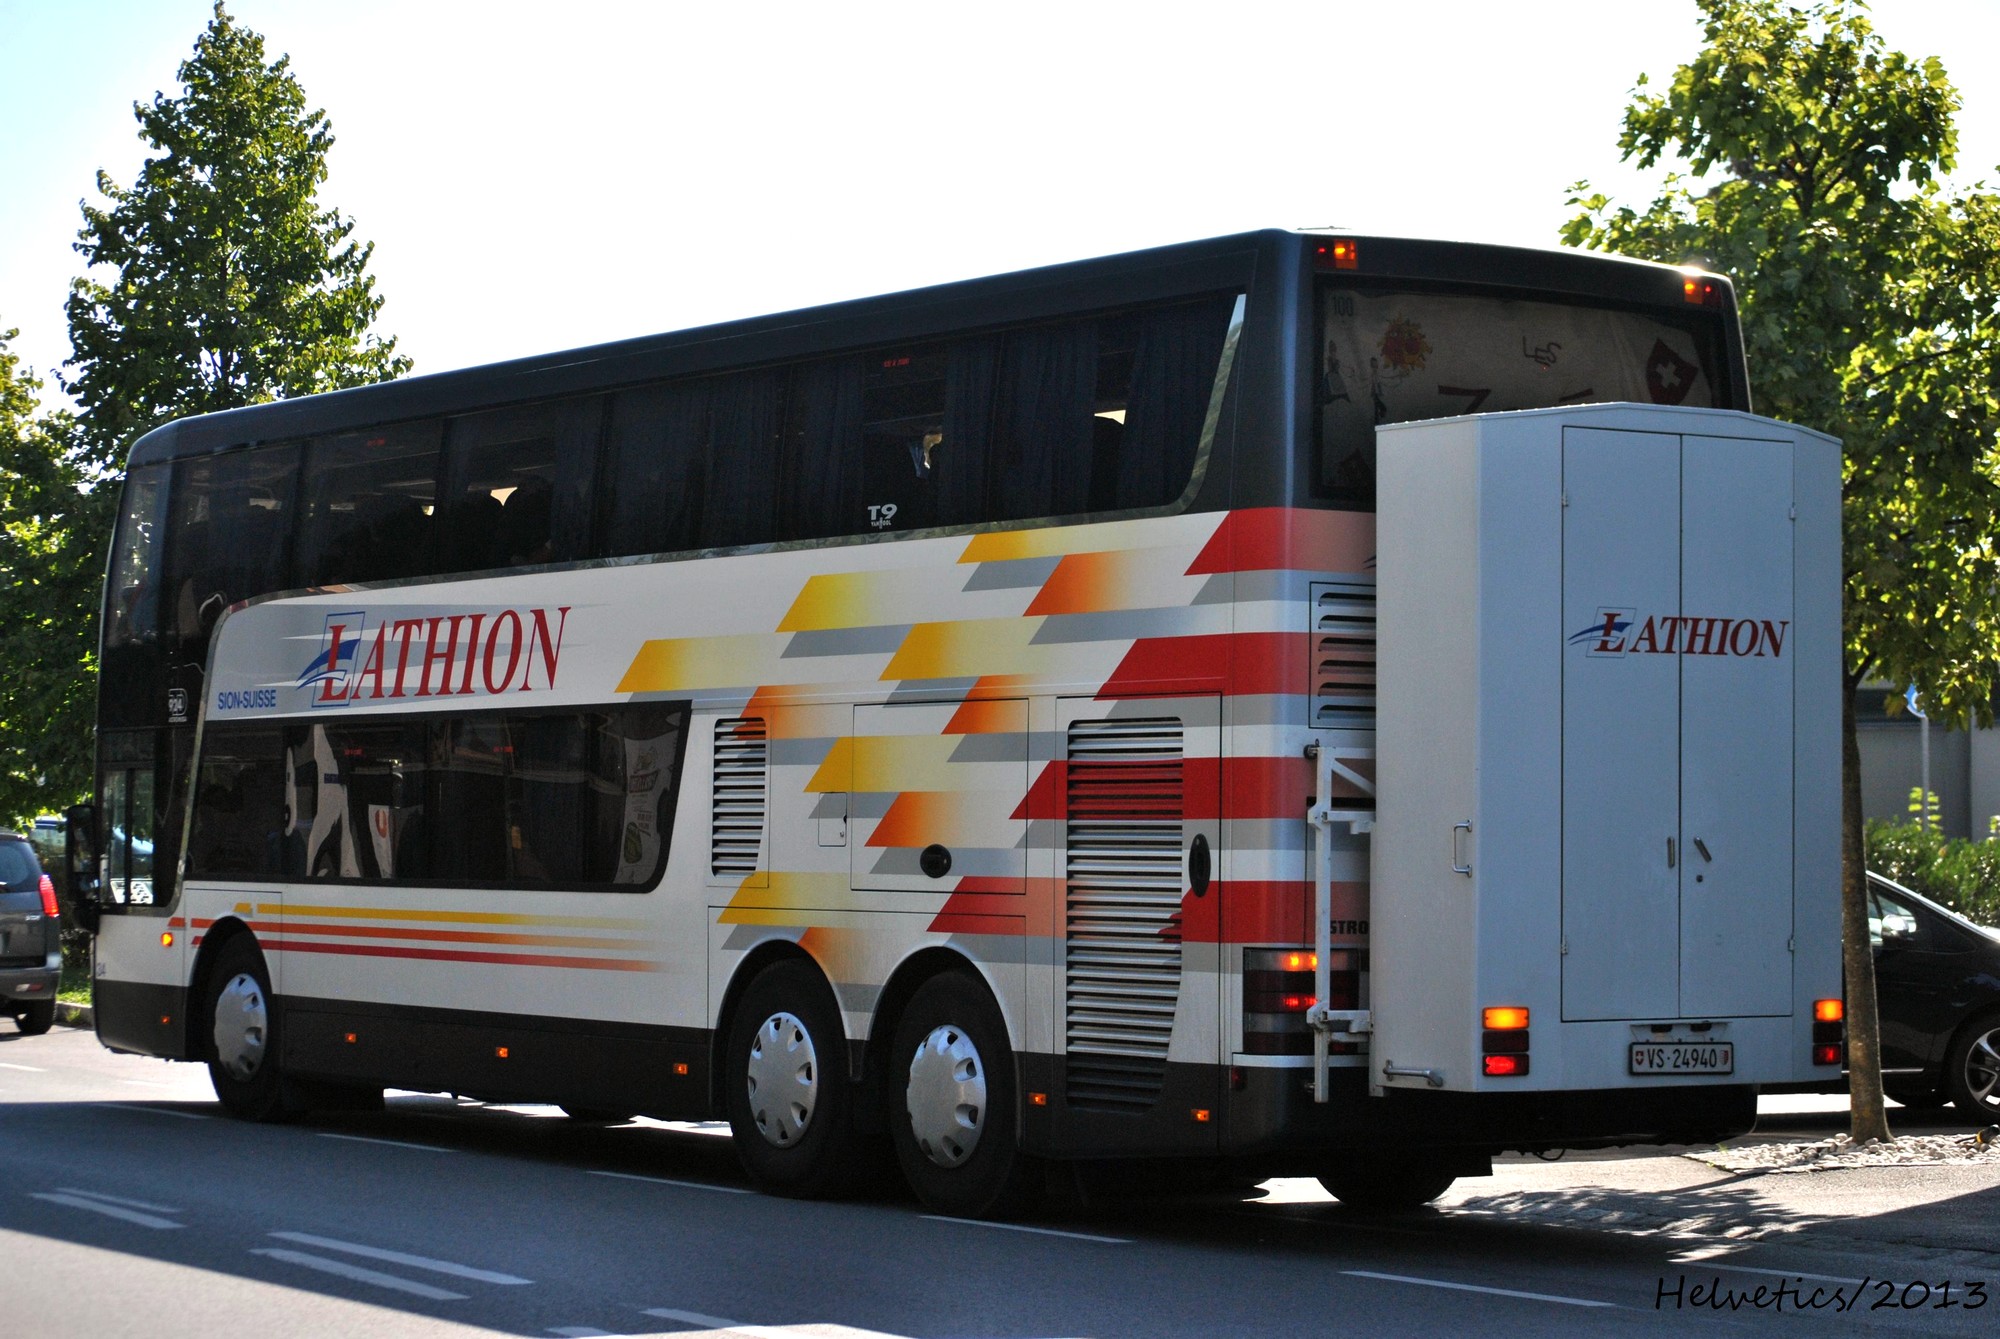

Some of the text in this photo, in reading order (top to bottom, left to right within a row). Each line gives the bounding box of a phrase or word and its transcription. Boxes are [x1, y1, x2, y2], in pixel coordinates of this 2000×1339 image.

[867, 503, 898, 520] T9
[1594, 613, 1789, 657] LATHION
[317, 607, 571, 701] LATHION
[218, 689, 277, 709] SION-SUISSE
[1647, 1048, 1717, 1068] VS 24940
